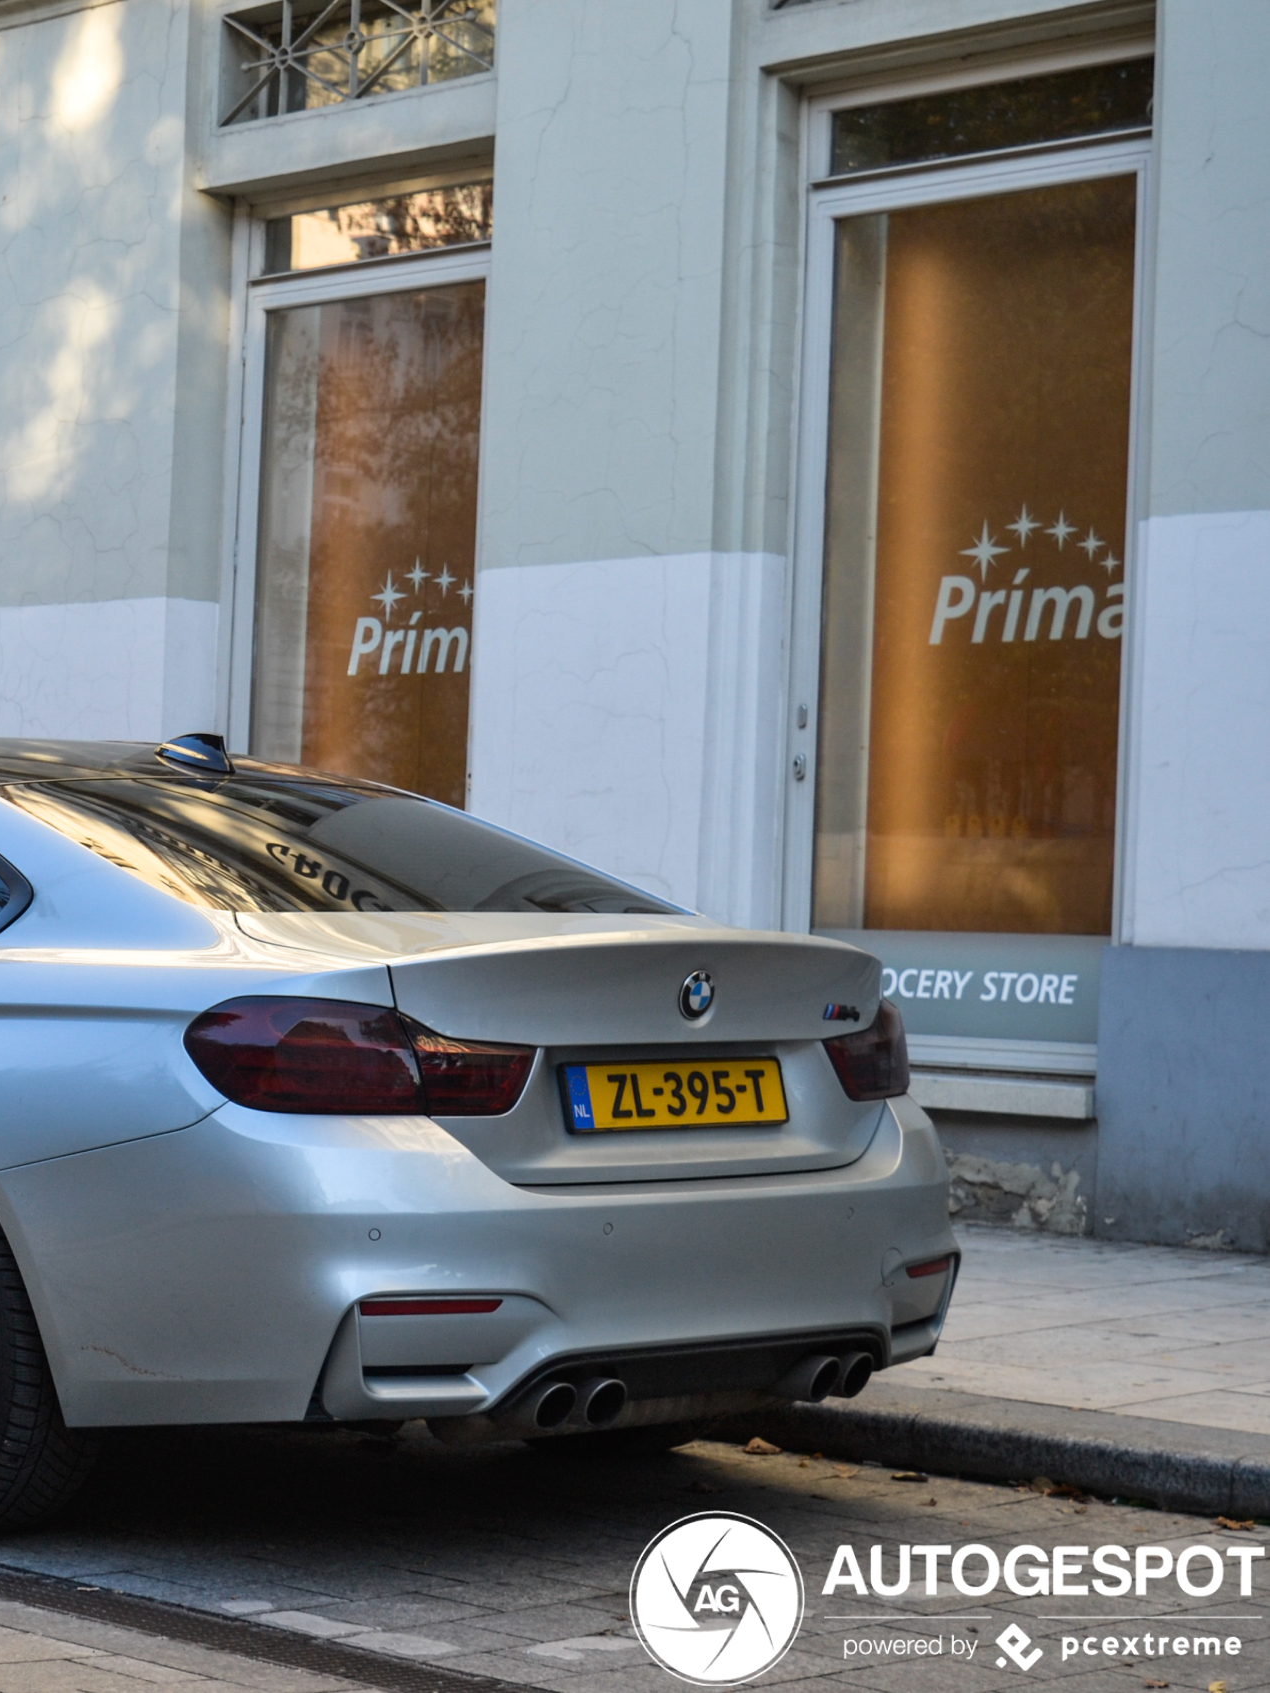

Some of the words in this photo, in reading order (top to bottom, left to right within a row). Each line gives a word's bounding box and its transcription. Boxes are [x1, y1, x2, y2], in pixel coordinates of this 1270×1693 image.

[980, 971, 1078, 1004] STORE
[607, 1069, 765, 1119] ZL-395-T
[574, 1104, 591, 1118] NL
